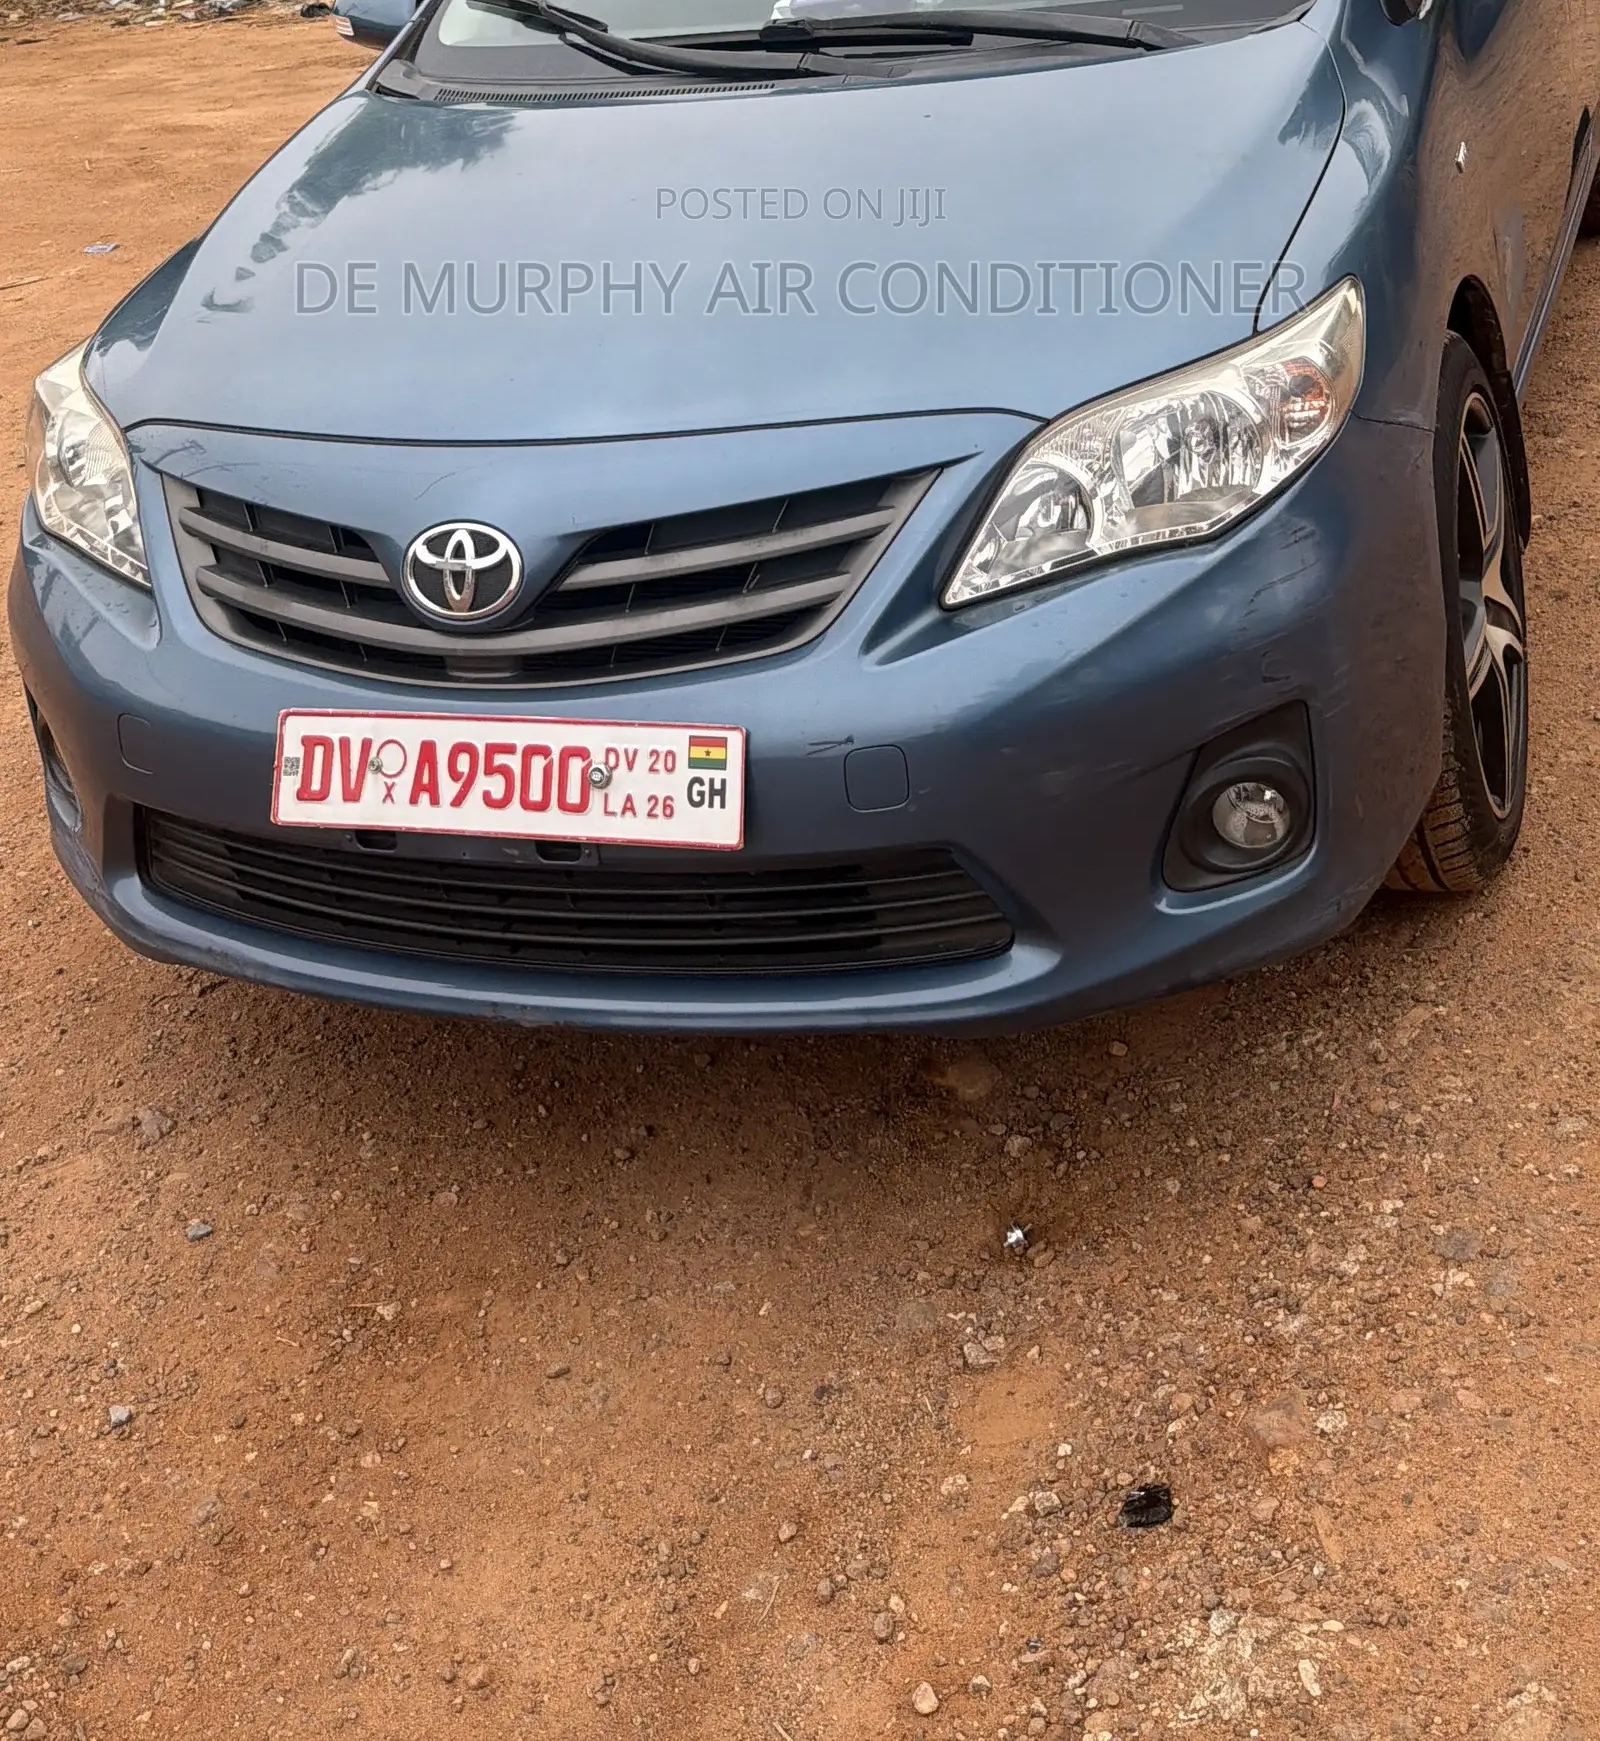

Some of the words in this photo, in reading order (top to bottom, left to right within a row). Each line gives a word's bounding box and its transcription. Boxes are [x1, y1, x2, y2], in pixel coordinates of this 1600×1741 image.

[296, 735, 373, 803] DV
[409, 739, 593, 814] A9500
[604, 746, 639, 773] DV
[648, 748, 677, 774] 20
[603, 792, 638, 818] LA
[646, 793, 676, 820] 26
[686, 775, 727, 810] GH
